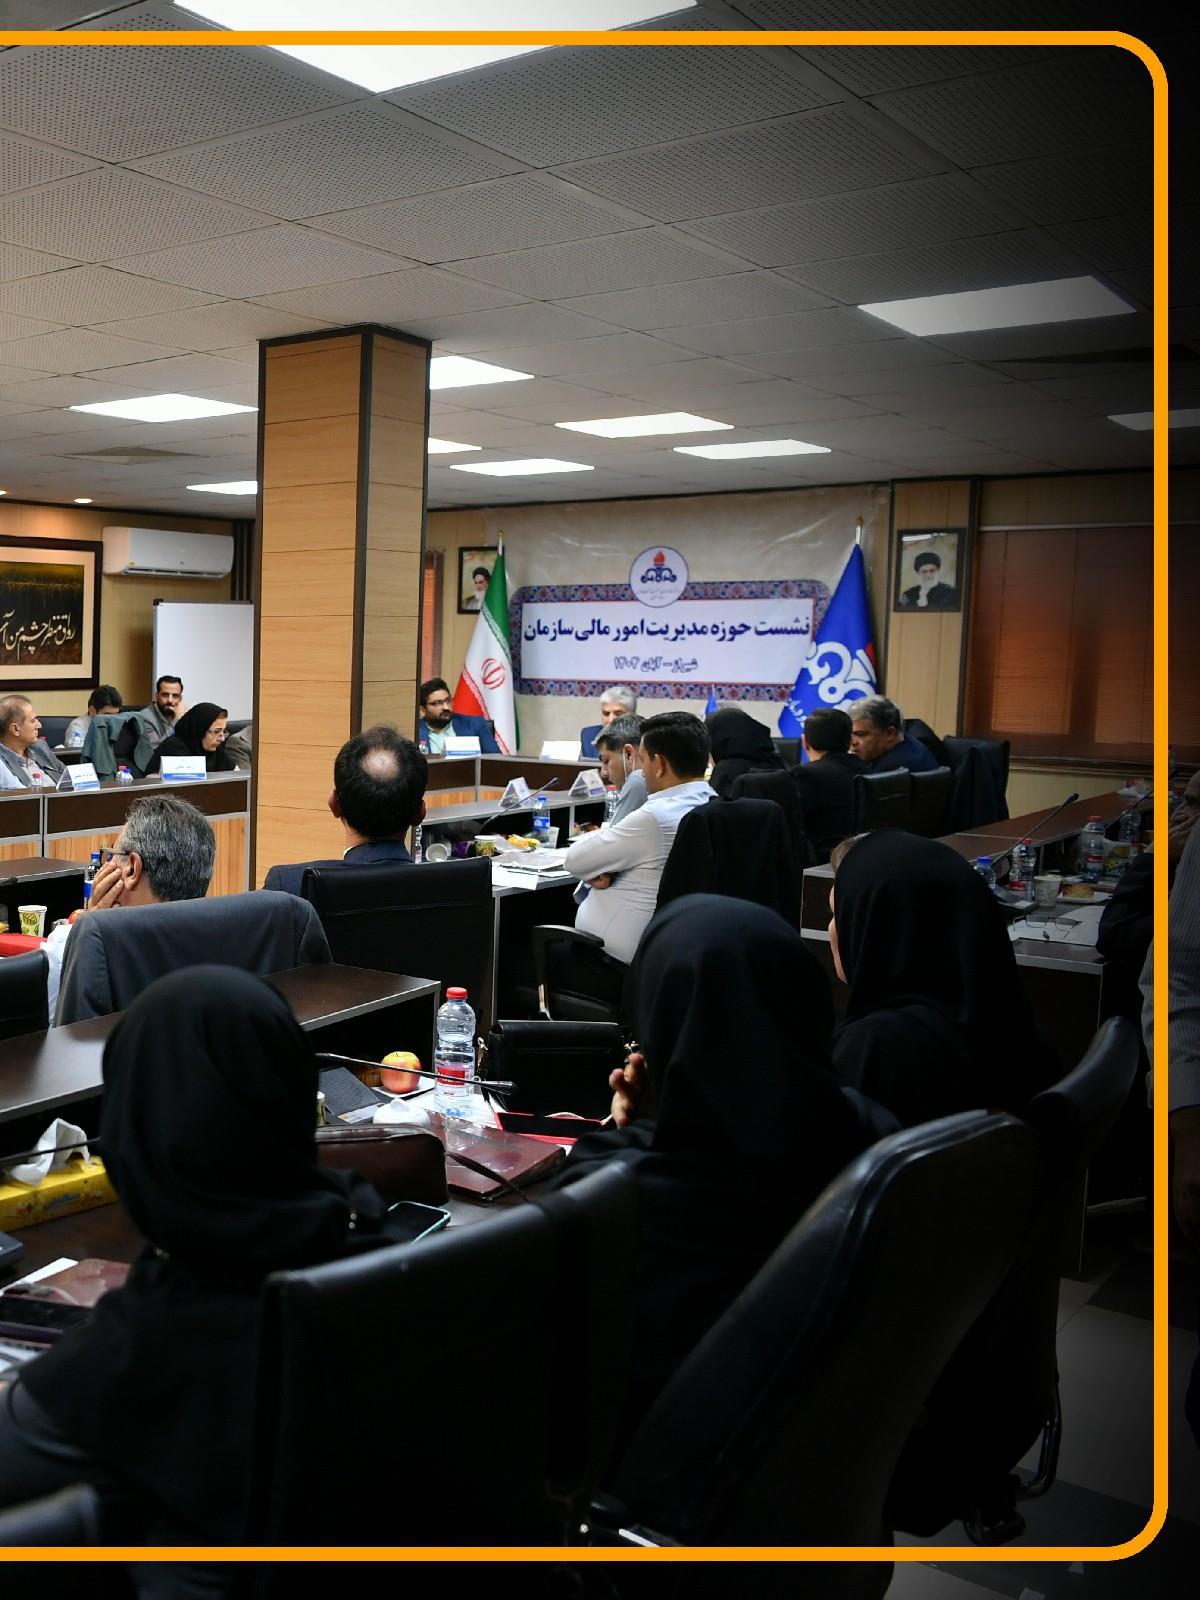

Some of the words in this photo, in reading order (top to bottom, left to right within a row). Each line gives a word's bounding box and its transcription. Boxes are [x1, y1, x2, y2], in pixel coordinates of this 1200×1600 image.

[523, 618, 574, 641] سازمان
[574, 618, 611, 641] مالی
[612, 618, 645, 642] امور
[646, 621, 709, 642] مدیریت
[710, 620, 751, 642] حوزه
[754, 616, 810, 636] نشست
